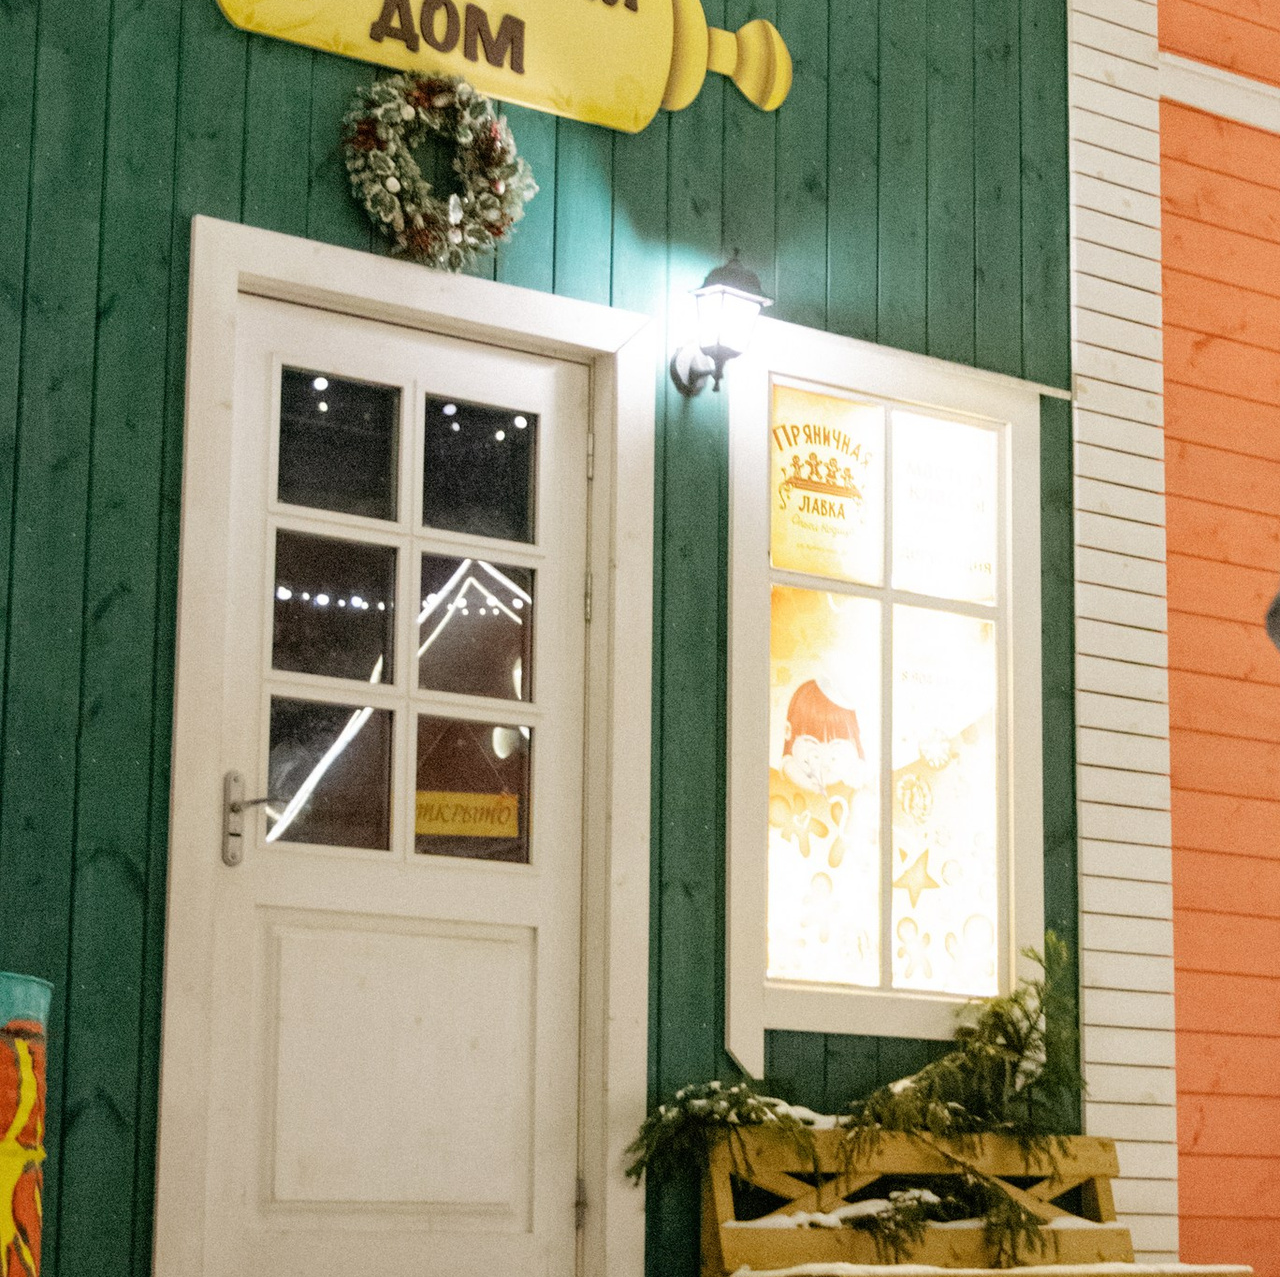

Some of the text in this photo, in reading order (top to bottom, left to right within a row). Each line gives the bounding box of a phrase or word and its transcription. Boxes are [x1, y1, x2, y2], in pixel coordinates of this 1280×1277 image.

[772, 422, 874, 468] ПРЯНИЧНАЯ
[798, 494, 846, 519] ЛАВКА
[416, 801, 512, 826] ткрыто
